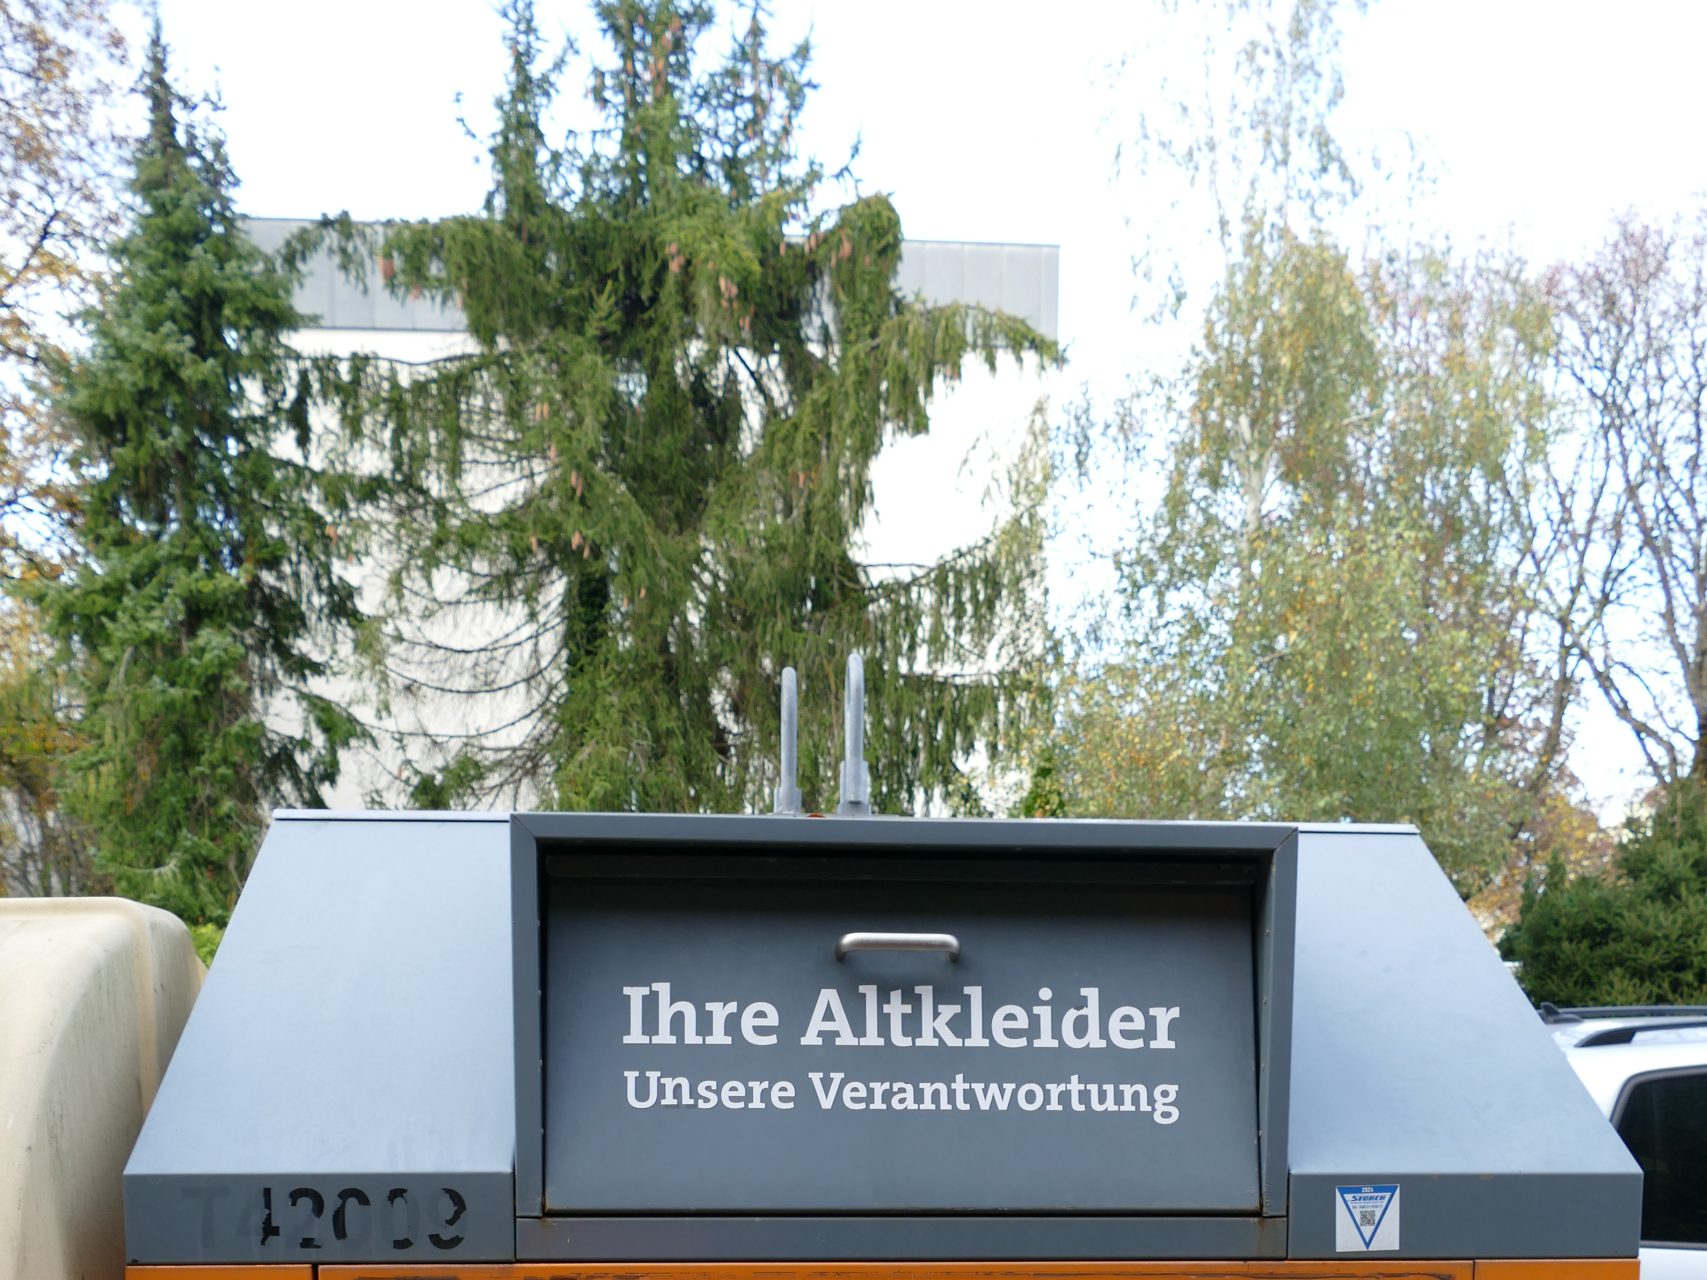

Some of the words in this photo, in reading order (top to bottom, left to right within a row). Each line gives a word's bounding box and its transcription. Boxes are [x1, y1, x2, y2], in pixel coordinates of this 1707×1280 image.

[623, 983, 779, 1045] Ihre
[800, 985, 1180, 1049] Altkleider
[624, 1071, 795, 1109] Unsere
[809, 1072, 1179, 1124] Verantwortung
